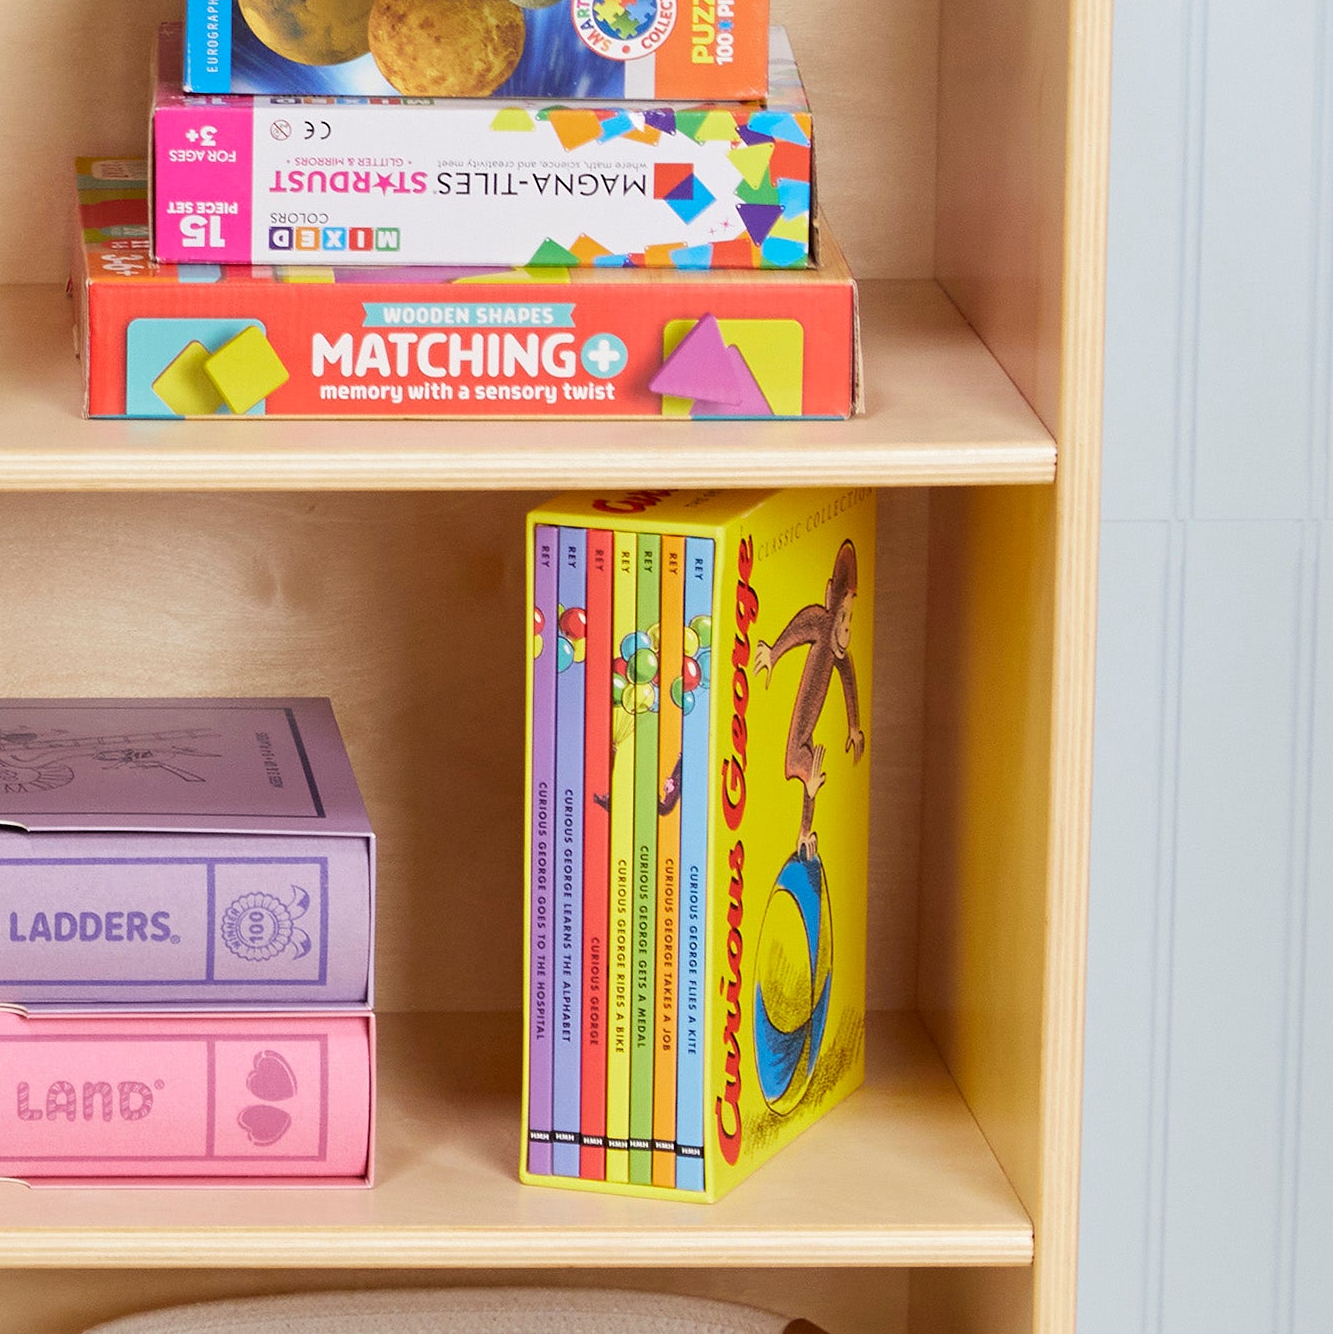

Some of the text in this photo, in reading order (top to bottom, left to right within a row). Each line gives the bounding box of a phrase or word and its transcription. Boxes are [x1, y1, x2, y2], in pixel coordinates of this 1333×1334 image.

[576, 0, 612, 53] SMART
[715, 32, 735, 66] 100
[185, 125, 218, 147] 3+
[169, 150, 237, 163] FOR AGES
[437, 172, 646, 196] MAGNA-TILES
[167, 201, 238, 214] PIECE SET
[270, 213, 329, 224] COLORS
[179, 215, 226, 248] 15
[270, 228, 400, 251] MIXED
[384, 307, 554, 325] WOODEN SHAPES
[320, 382, 616, 404] memory with a sensory twist
[757, 525, 803, 561] CLASSIC
[715, 534, 760, 1167] Curious George
[536, 782, 548, 1041] CURIOUS GEORGE GOES TO THE HOSPITAL
[562, 788, 573, 1043] CURIOUS GEORGE LEARNS THE ALPHABET
[249, 911, 264, 944] 100
[615, 859, 627, 1054] CURIOUS GEORGE RIDES A BIKE
[637, 845, 649, 1049] CURIOUS GEORGE GETS A MEDAL
[662, 858, 674, 1052] CURIOUS GEORGE TAKES A JOB
[687, 865, 699, 1055] CURIOUS GEORGE FLIES A KITE
[590, 936, 600, 1046] CURIOUS GEORGE
[17, 1080, 154, 1123] LAND
[530, 1131, 550, 1141] HMH
[555, 1132, 575, 1142] HMH
[583, 1136, 603, 1146] HMH
[608, 1139, 628, 1149] HMH
[629, 1139, 649, 1149] HMH
[655, 1141, 674, 1150] HMH
[681, 1146, 701, 1156] HMH
